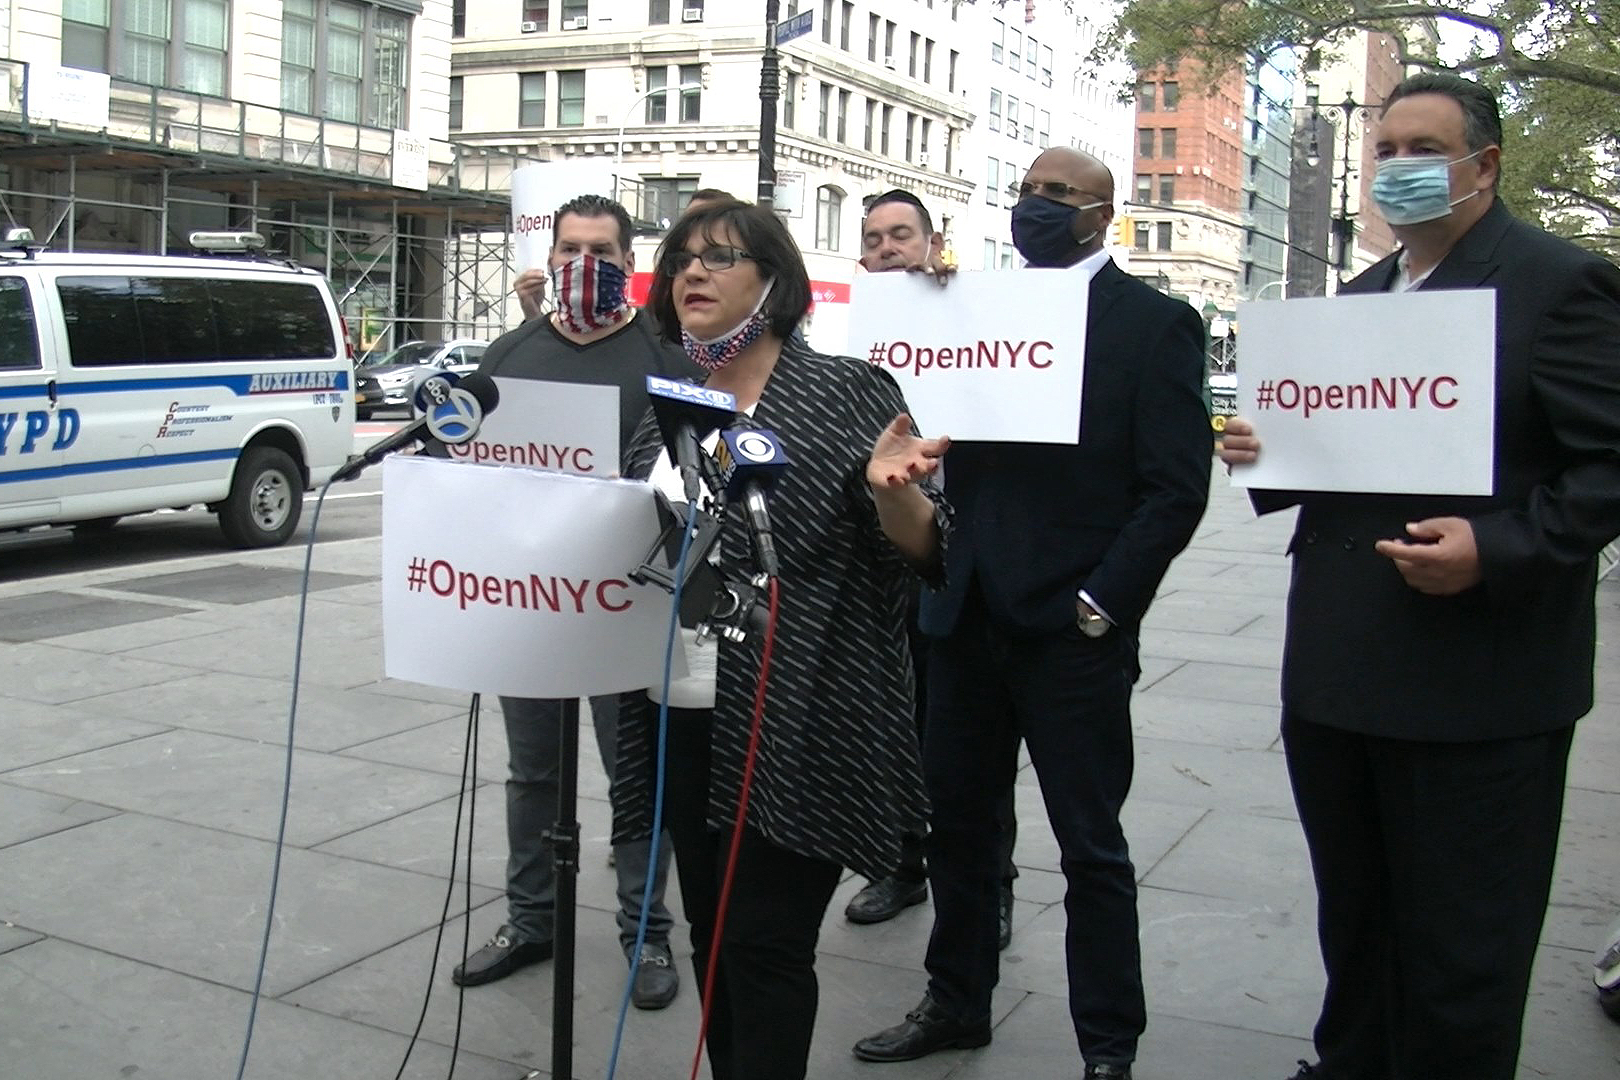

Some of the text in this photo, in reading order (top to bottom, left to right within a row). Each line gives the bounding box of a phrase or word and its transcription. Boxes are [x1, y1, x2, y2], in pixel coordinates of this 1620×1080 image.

[516, 213, 553, 237] #Open
[868, 340, 1054, 376] #OpenNYC
[249, 371, 338, 393] AUXILIARY
[425, 379, 447, 405] abc
[1257, 375, 1459, 418] #OpenNYC
[447, 440, 595, 472] OpenNYC
[407, 557, 632, 613] #OpenNYC
